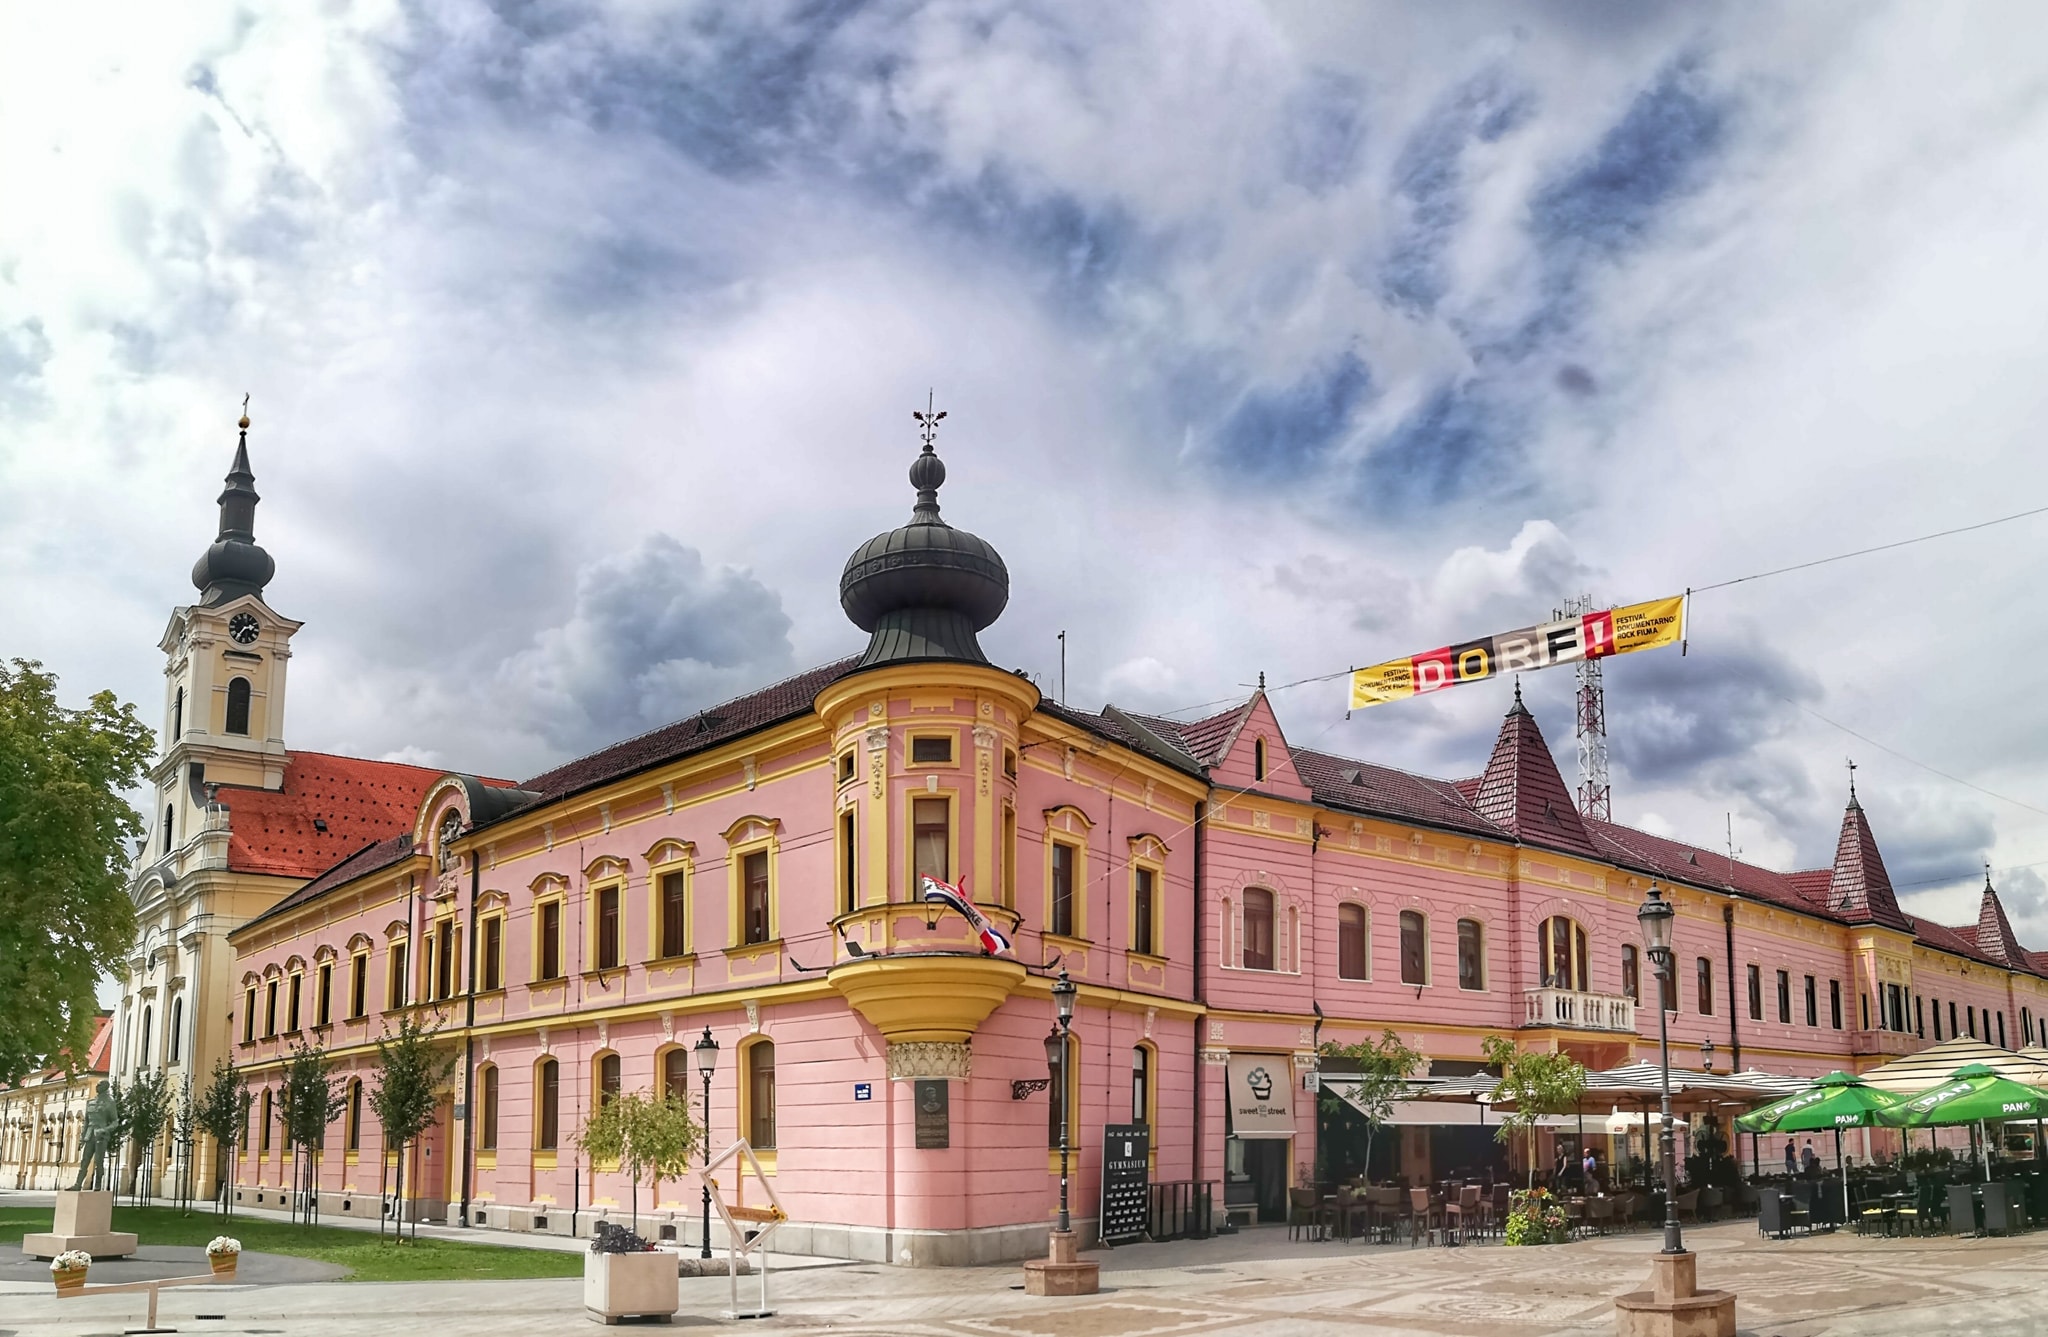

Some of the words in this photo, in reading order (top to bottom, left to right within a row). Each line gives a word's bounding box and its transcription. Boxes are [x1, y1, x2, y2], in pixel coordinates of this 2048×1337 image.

[1616, 613, 1647, 624] FESTIVAL
[1617, 631, 1635, 640] ROCK
[1636, 627, 1658, 636] FILMA
[1920, 1083, 1971, 1106] PAN
[1774, 1092, 1822, 1114] PAN
[2002, 1102, 2023, 1112] PAN
[1239, 1107, 1258, 1115] sweet
[1268, 1107, 1286, 1115] street
[1835, 1115, 1852, 1124] PAN
[1108, 1159, 1146, 1170] GYMNASIUM
